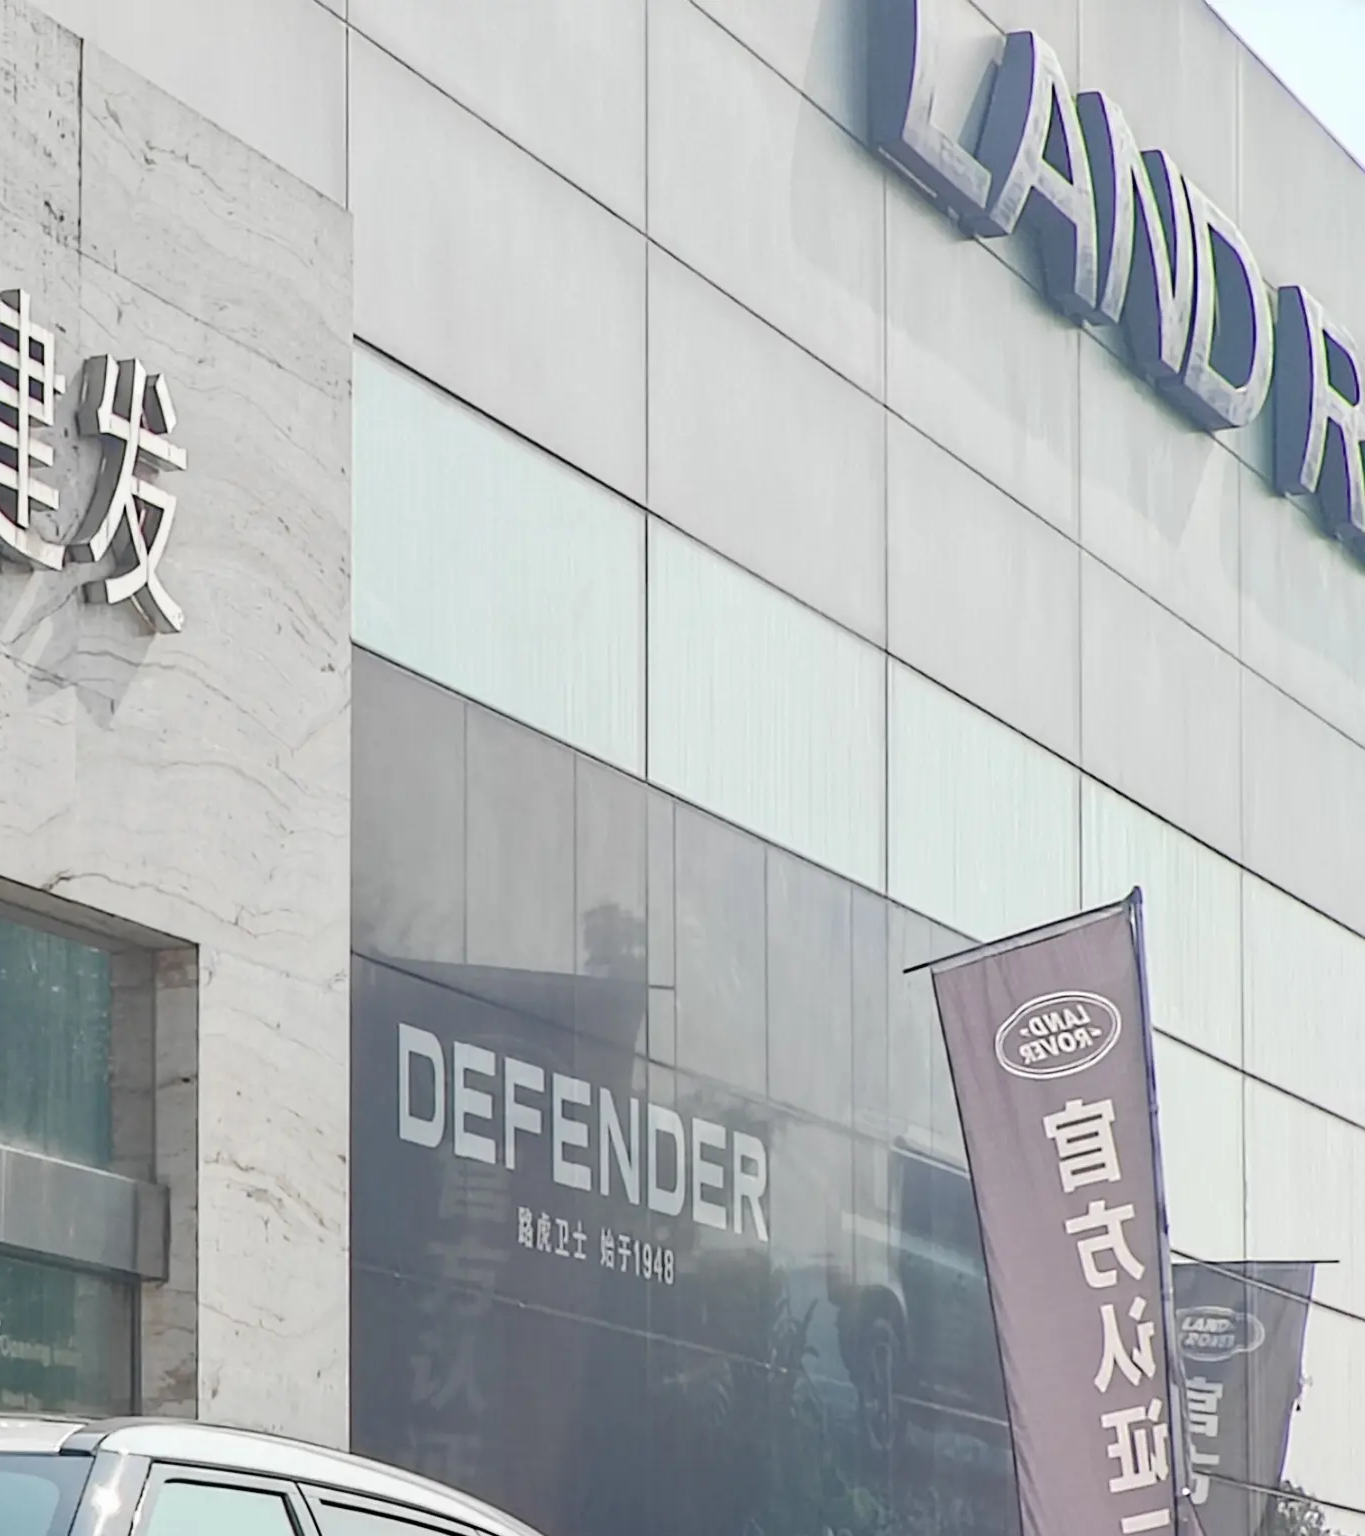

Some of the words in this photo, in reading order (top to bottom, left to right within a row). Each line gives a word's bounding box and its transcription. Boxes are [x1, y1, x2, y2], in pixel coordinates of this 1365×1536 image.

[869, 0, 1272, 430] LAND
[398, 1022, 769, 1243] DEFENDER
[517, 1205, 588, 1260] 路虎卫士
[599, 1227, 675, 1286] 始于1948
